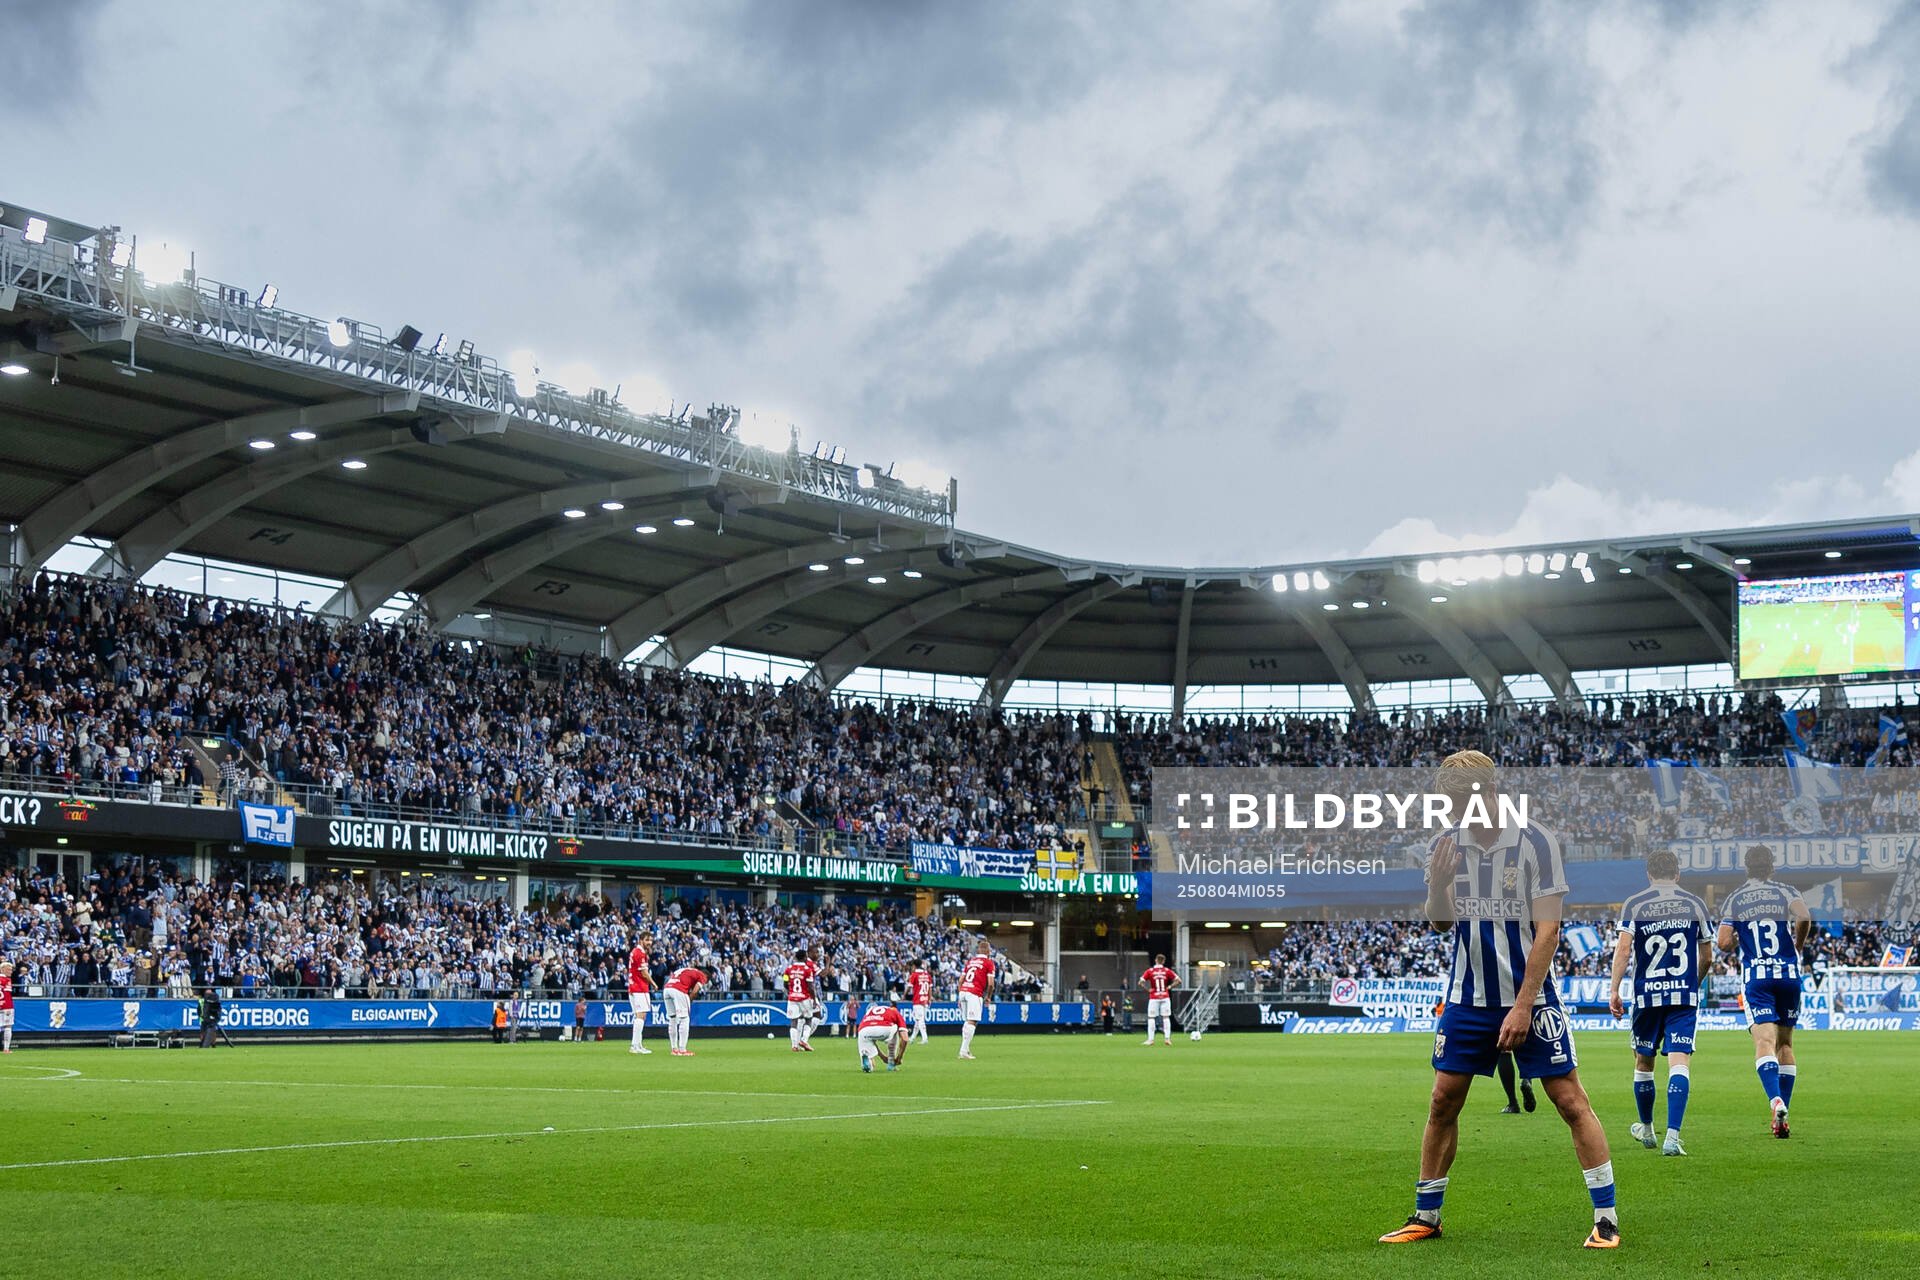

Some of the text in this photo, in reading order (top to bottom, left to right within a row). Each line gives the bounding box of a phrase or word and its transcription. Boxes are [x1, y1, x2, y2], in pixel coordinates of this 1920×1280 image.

[329, 820, 548, 859] SUGEN PÅ EN UMAMI-KICK?
[743, 851, 782, 875] SUGEN
[787, 853, 801, 876] PÅ
[806, 856, 821, 878] EN
[825, 858, 897, 883] UMAMI-KICK?
[1093, 874, 1112, 893] EN
[1738, 904, 1785, 922] SVENSSON
[1748, 918, 1780, 959] 13
[1645, 932, 1689, 979] 23
[965, 967, 975, 983] 6
[792, 977, 803, 993] 8
[919, 981, 929, 995] 20
[1155, 978, 1166, 993] 11
[1382, 980, 1395, 990] EN
[1644, 980, 1689, 992] MOBILL
[220, 1004, 310, 1027] GÖTEBORG
[352, 1009, 427, 1021] ELGIGANTEN
[731, 1008, 770, 1025] cuebid
[1260, 1011, 1300, 1024] RASTA
[1830, 1013, 1902, 1030] Renova
[1291, 1017, 1394, 1034] Interbus
[1535, 1009, 1563, 1039] MG
[1553, 1041, 1563, 1055] 9
